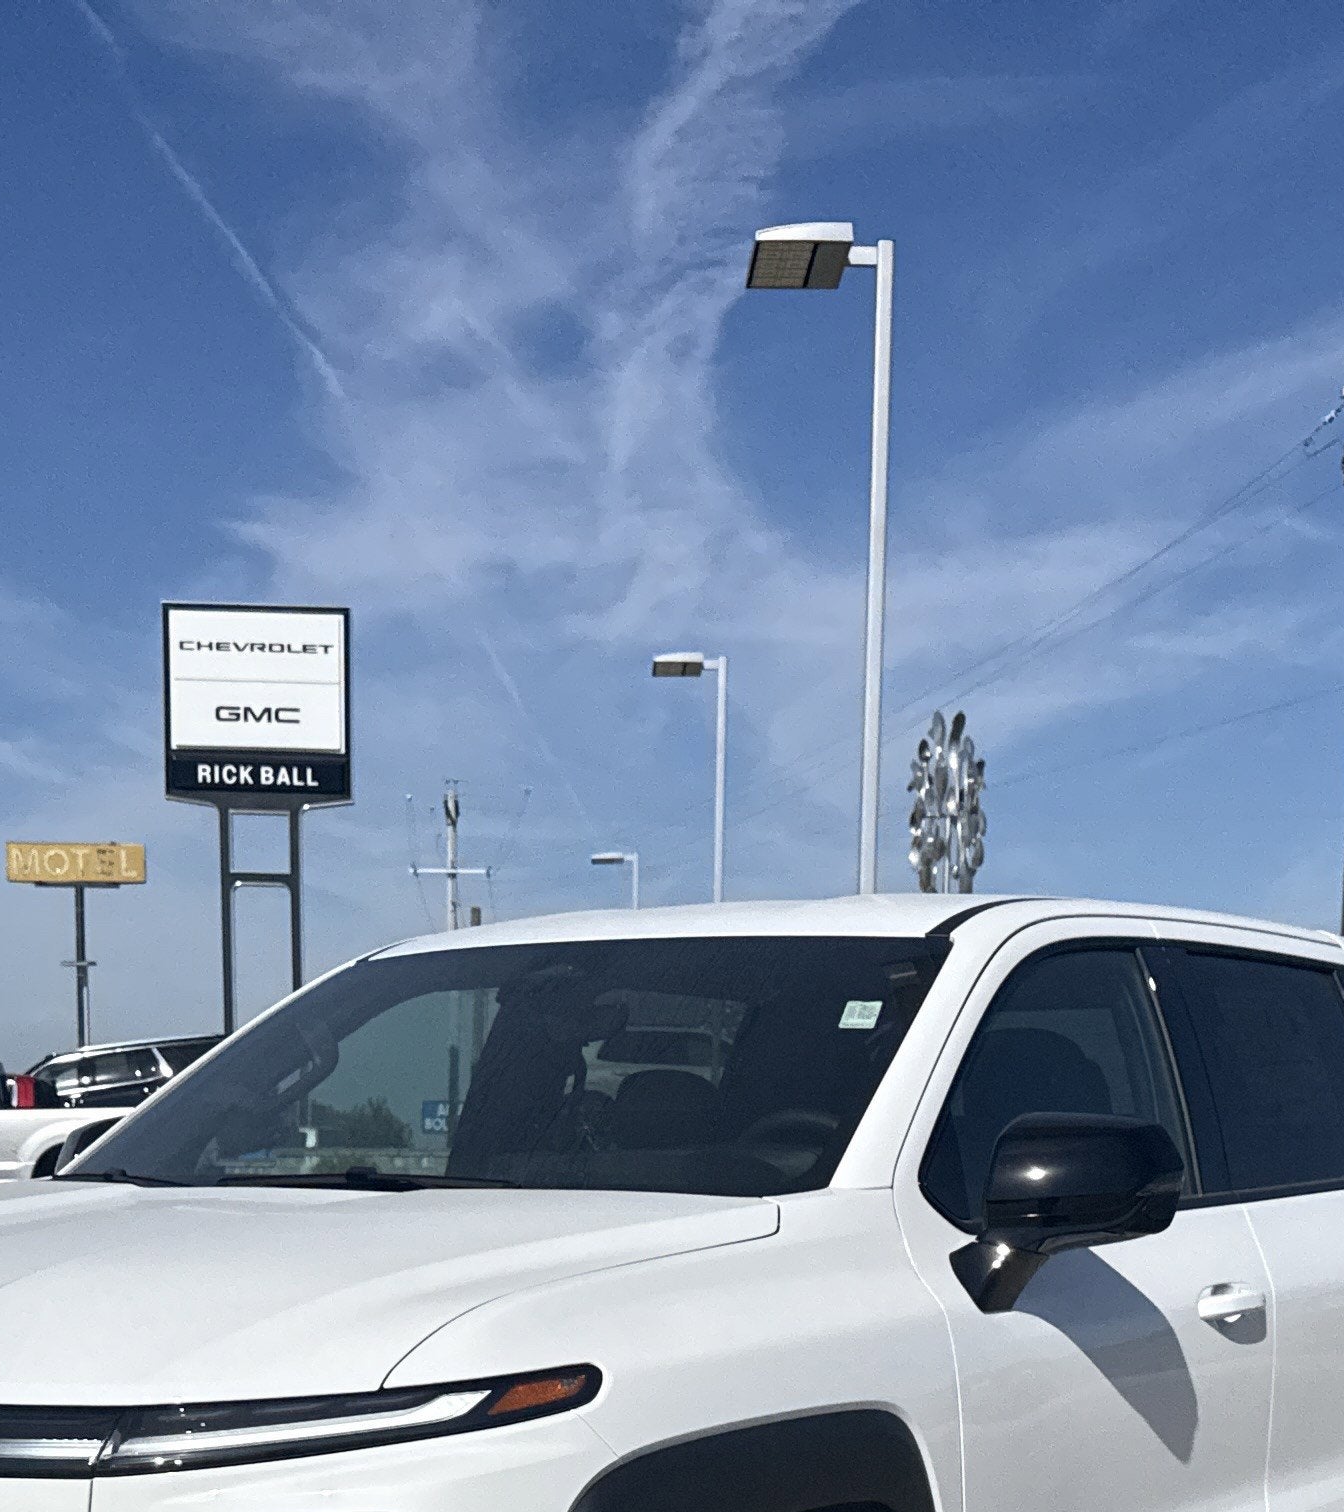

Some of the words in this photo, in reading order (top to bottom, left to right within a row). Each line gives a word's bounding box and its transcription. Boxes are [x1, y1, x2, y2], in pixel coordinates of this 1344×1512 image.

[178, 640, 333, 655] CHEVROLET
[214, 705, 301, 724] GMC
[197, 764, 253, 786] RICK
[260, 766, 319, 787] BALL
[10, 847, 139, 879] MOTEL
